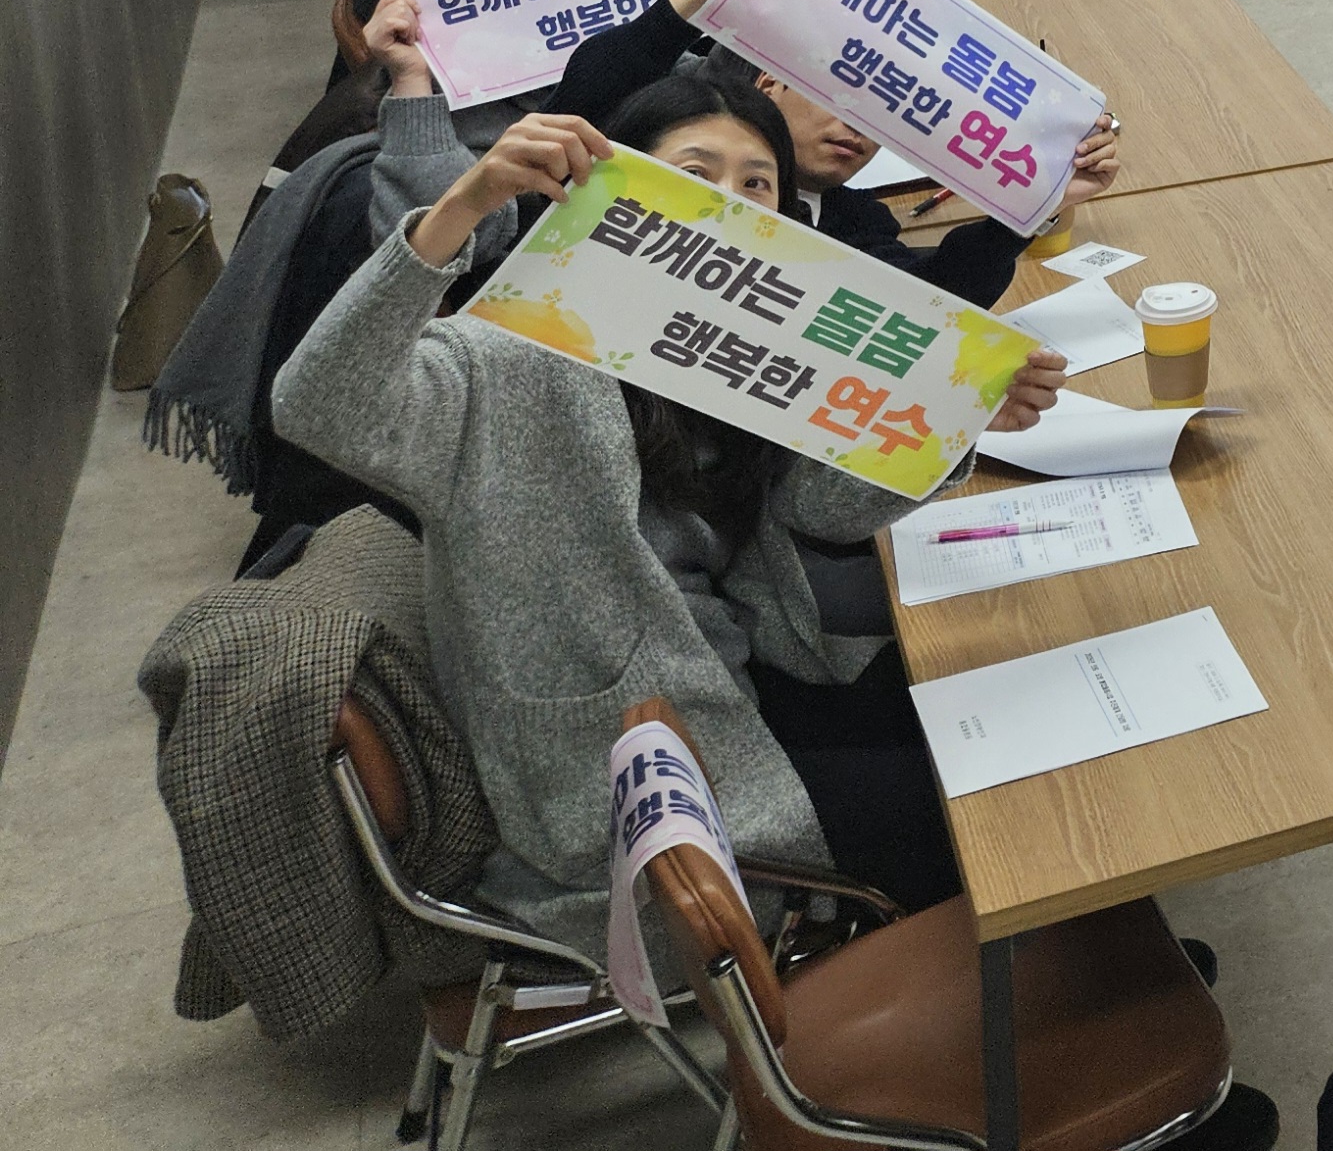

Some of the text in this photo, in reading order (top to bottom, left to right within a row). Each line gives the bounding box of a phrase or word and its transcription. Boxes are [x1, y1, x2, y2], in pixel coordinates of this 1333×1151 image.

[829, 36, 1038, 190] 행복한 연수
[941, 32, 1038, 120] 돌봄
[589, 195, 806, 326] 함께하는
[801, 286, 940, 379] 돌봄
[650, 311, 933, 457] 행복한 연수
